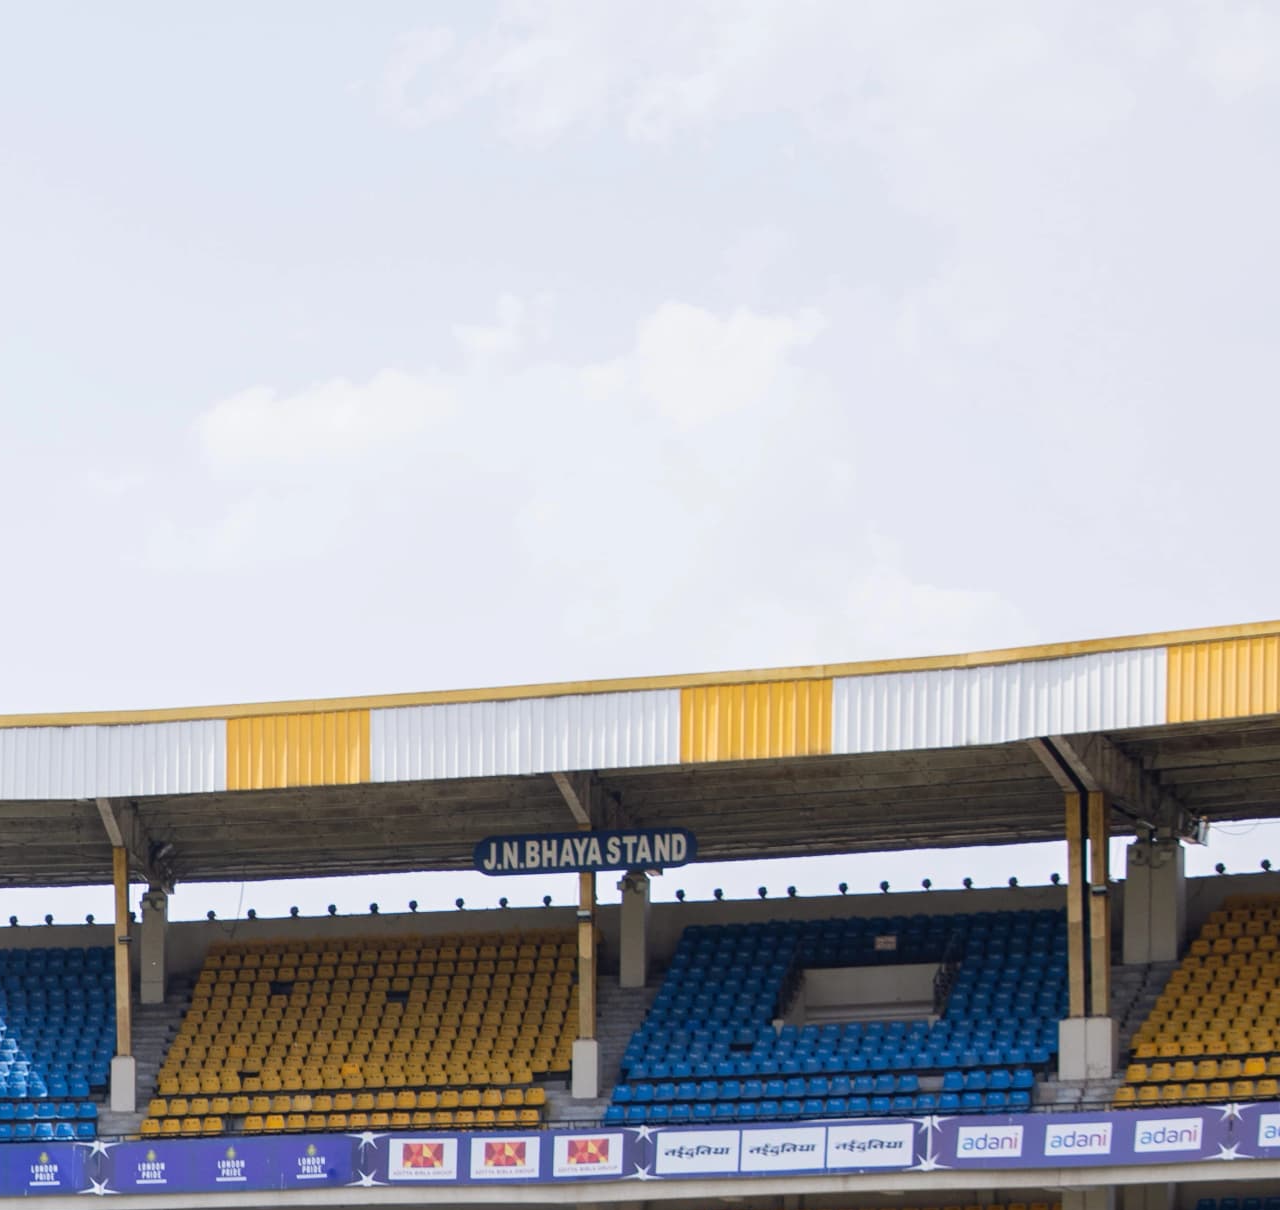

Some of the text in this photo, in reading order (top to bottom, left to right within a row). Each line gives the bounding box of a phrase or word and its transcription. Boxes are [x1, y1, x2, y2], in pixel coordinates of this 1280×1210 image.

[484, 833, 686, 870] J.N.BHAYA STAND
[1140, 1124, 1198, 1144] adani
[962, 1133, 1019, 1150] adani
[1050, 1130, 1108, 1148] adani
[218, 1160, 245, 1169] LONDON
[298, 1157, 325, 1166] LONDON
[31, 1164, 58, 1173] LONDON
[138, 1162, 165, 1171] LONDON
[302, 1165, 322, 1174] PRIDE
[141, 1170, 161, 1179] PRIDE
[221, 1168, 241, 1177] PRIDE
